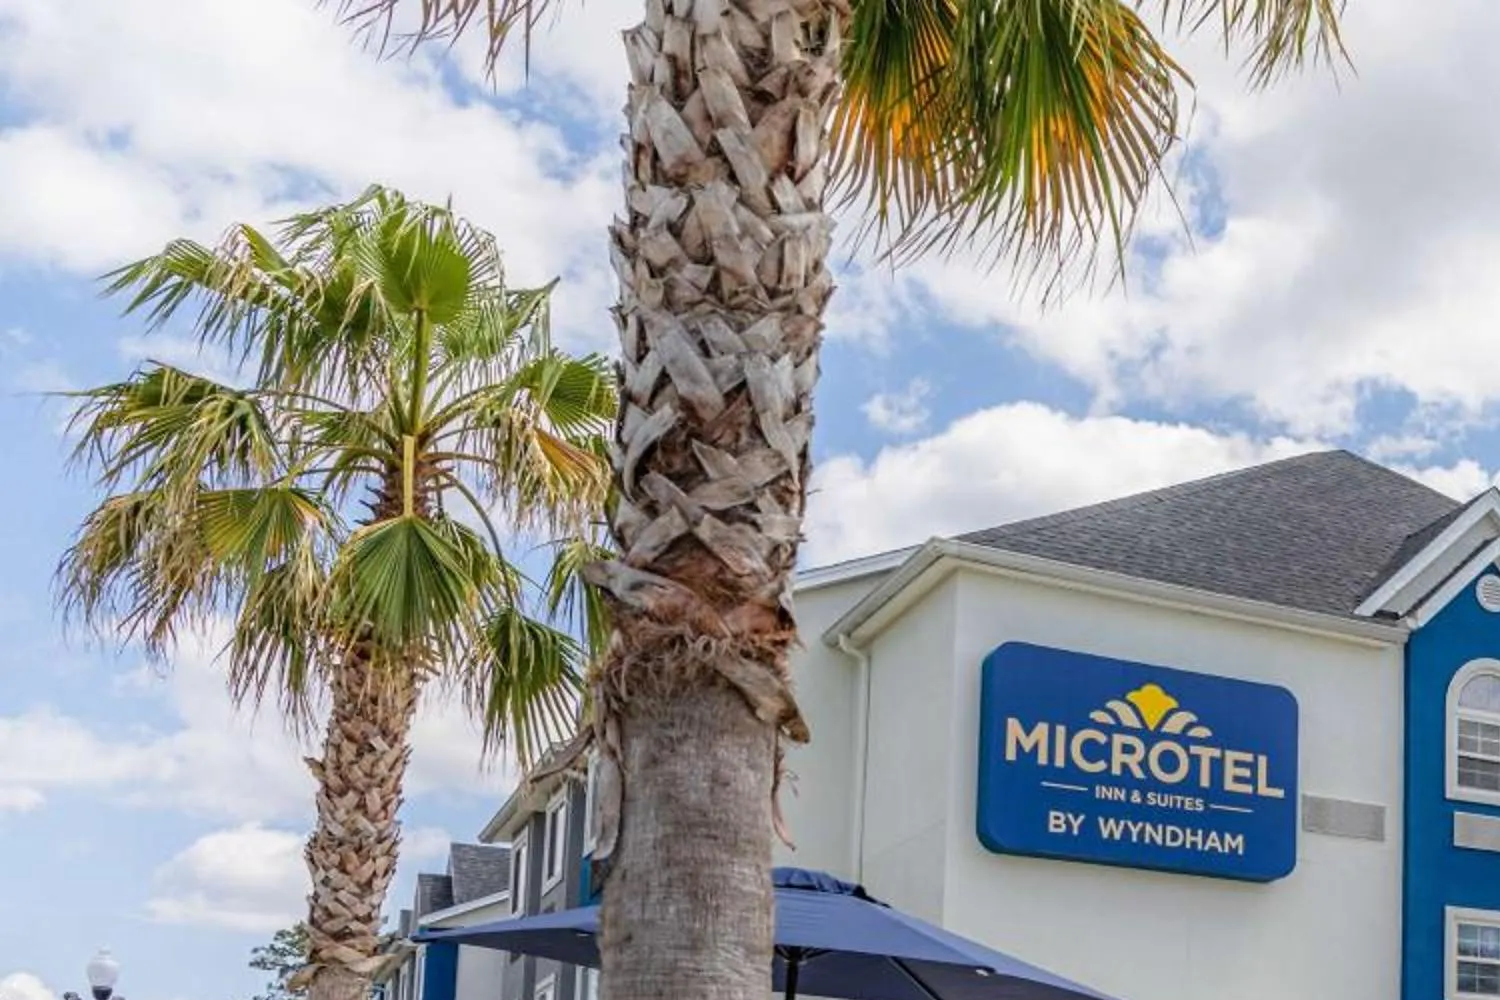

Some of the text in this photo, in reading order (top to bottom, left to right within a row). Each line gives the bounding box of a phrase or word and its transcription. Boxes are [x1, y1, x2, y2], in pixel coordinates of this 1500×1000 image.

[1005, 717, 1285, 799] MICROTEL
[1095, 785, 1204, 811] INN & SUITES
[1048, 811, 1245, 855] BY WYNDHAM
